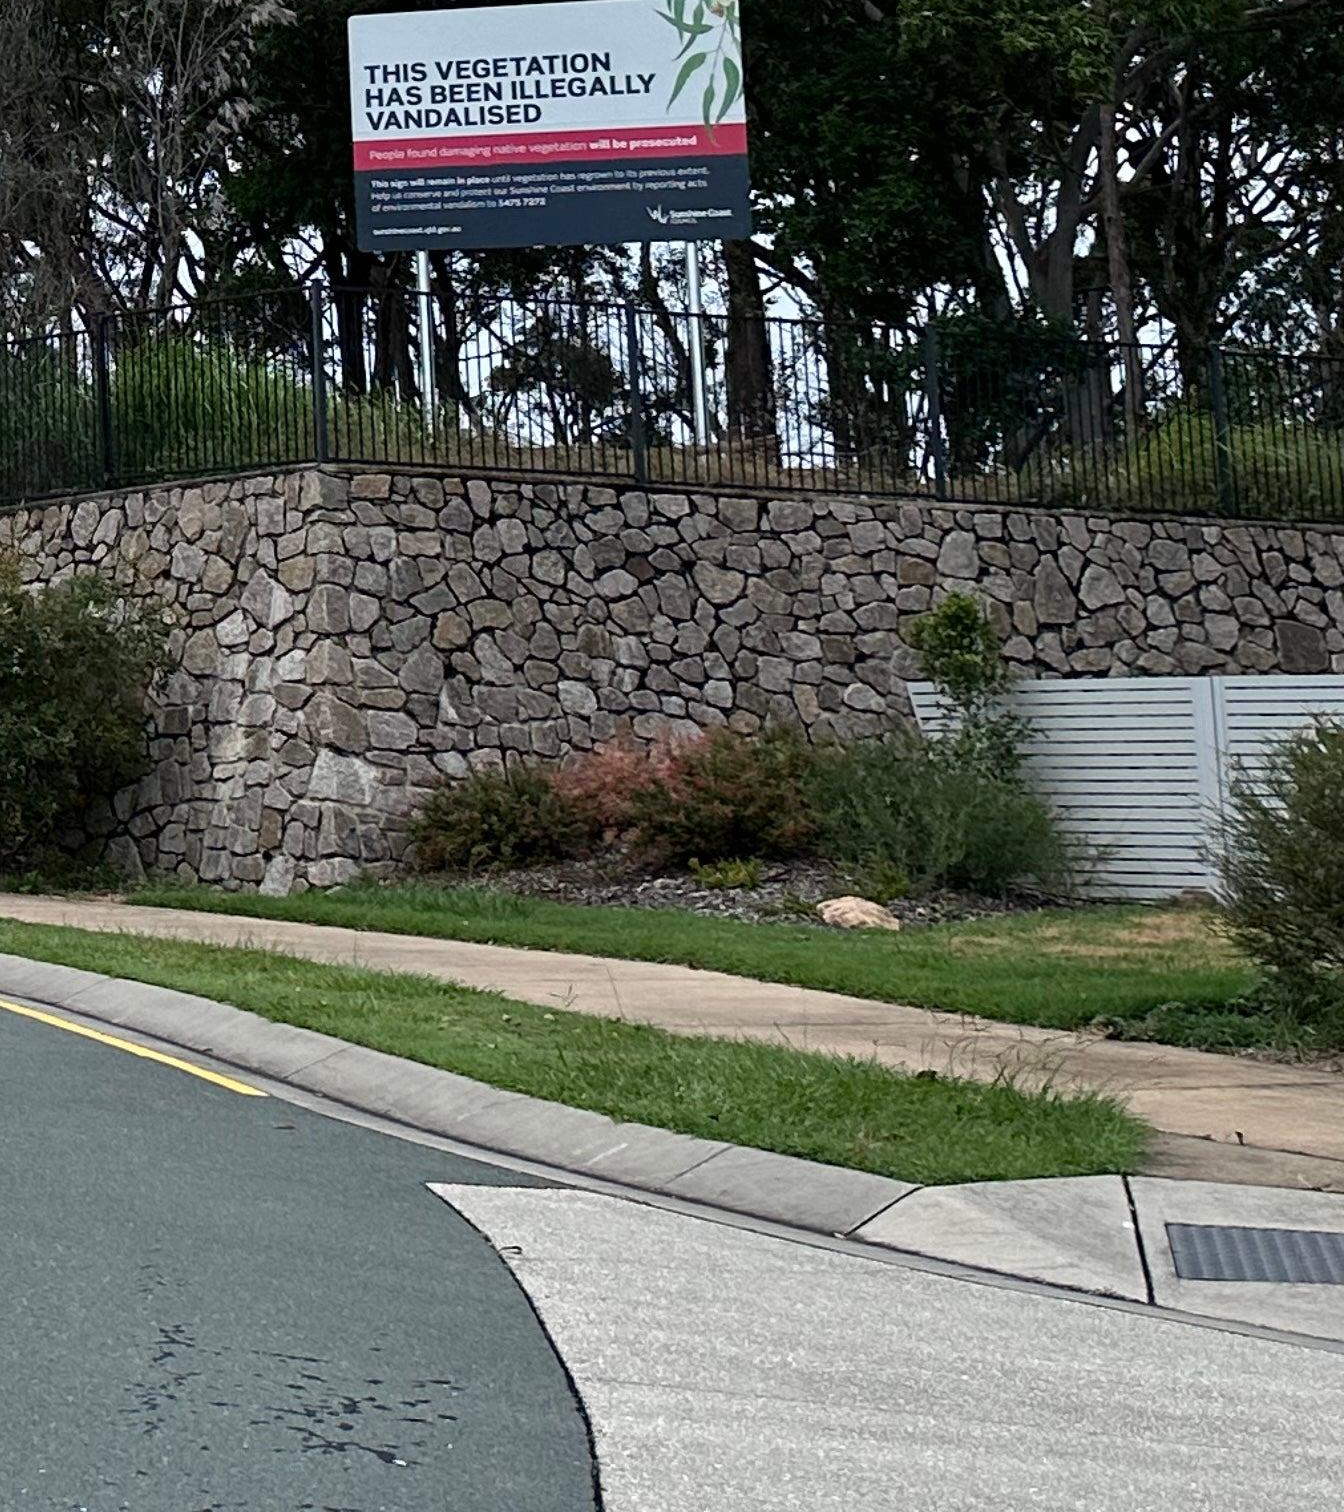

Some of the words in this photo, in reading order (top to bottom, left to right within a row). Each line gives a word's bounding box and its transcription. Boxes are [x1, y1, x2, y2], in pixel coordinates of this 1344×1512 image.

[364, 62, 426, 84] THIS
[435, 52, 611, 81] VEGETATION
[365, 86, 422, 107] HAS
[430, 81, 502, 104] BEEN
[511, 73, 657, 100] ILLEGALLY
[366, 103, 542, 130] VANDALISED
[369, 149, 405, 160] People
[406, 147, 437, 157] found
[439, 146, 491, 158] damaging
[493, 144, 526, 154] native
[529, 140, 588, 154] vegetation
[589, 138, 611, 149] will
[612, 138, 627, 148] be
[629, 135, 698, 150] prosecuted
[370, 180, 389, 188] This
[390, 179, 408, 189] sign
[409, 178, 425, 187] will
[426, 178, 456, 186] remain
[456, 177, 466, 185] in
[466, 176, 490, 186] place
[491, 174, 511, 183] until
[512, 172, 559, 183] vegetation
[559, 172, 576, 180] has
[577, 170, 613, 181] regrown
[614, 169, 625, 178] to
[626, 169, 637, 177] its
[639, 168, 676, 178] previous
[370, 193, 391, 202] Help
[403, 190, 442, 199] conserve
[443, 189, 460, 197] and
[460, 188, 492, 197] protect
[493, 188, 507, 196] our
[509, 186, 548, 195] Sunshine
[550, 184, 575, 193] Coast
[576, 182, 631, 192] environment
[632, 181, 643, 191] by
[644, 180, 686, 191] reporting
[687, 179, 708, 188] acts
[371, 203, 381, 212] of
[382, 201, 442, 212] environmental
[486, 199, 497, 208] to
